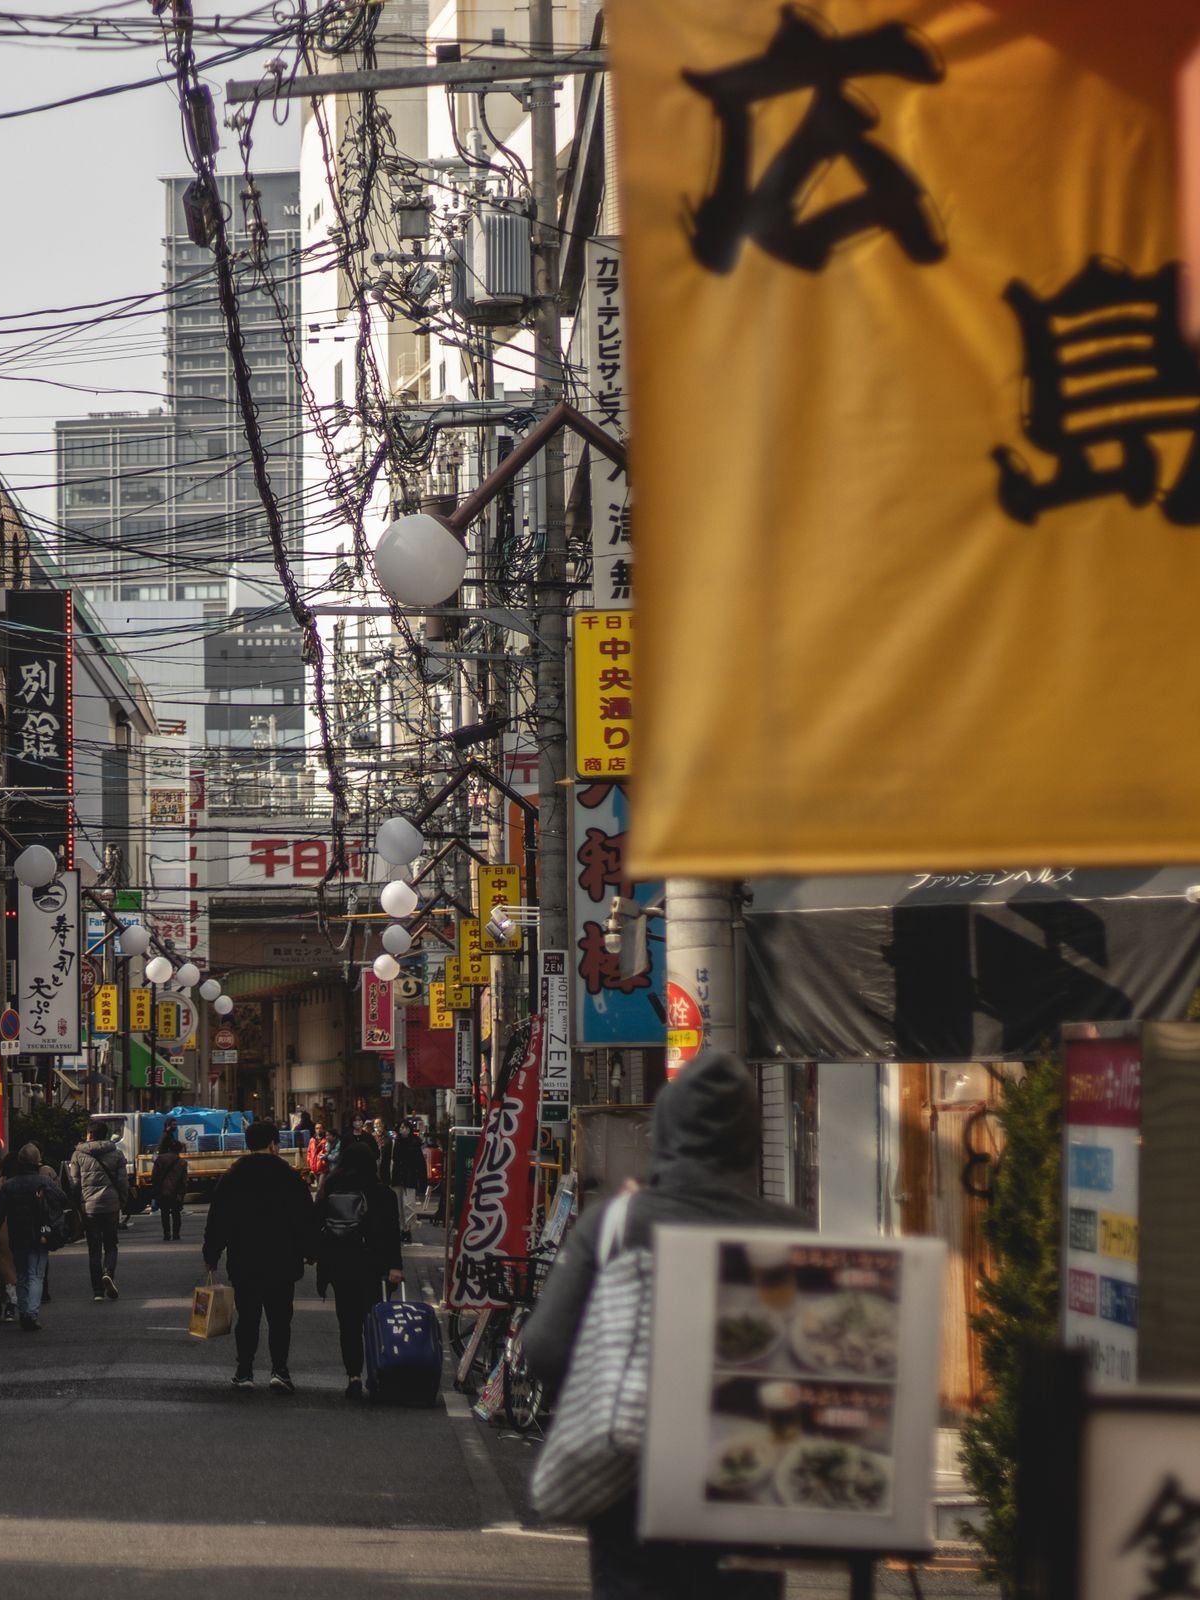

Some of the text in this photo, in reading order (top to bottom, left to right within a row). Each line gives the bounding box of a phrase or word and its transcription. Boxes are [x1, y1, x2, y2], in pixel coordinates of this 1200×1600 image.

[596, 256, 623, 427] カラーテレビサービス
[581, 616, 634, 630] 千日
[599, 636, 633, 750] 中央通り
[584, 757, 627, 772] 商店
[481, 867, 516, 875] 千日前
[544, 962, 563, 972] ZEN
[101, 991, 111, 1025] 中央通り
[135, 995, 145, 1025] 中央通り
[558, 976, 568, 1015] HOTEL
[549, 1033, 567, 1079] ZEN
